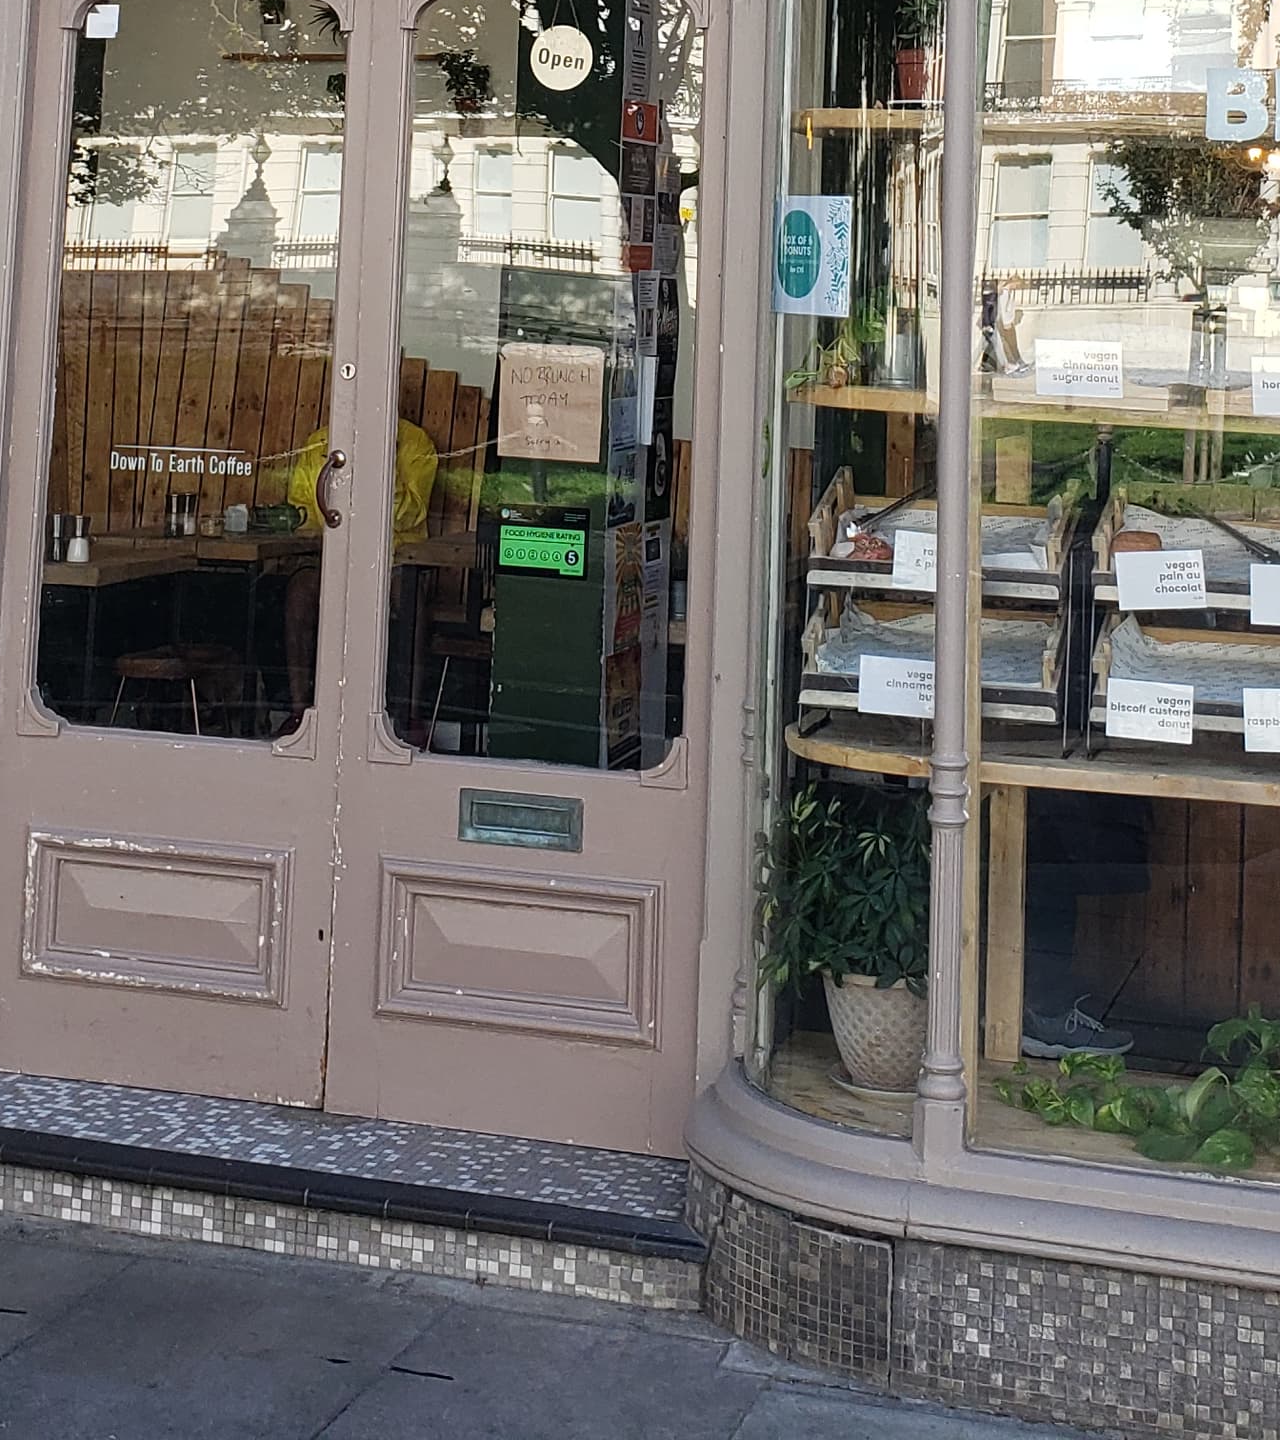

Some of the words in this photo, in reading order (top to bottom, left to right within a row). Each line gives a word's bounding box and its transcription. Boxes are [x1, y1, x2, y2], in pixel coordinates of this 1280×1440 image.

[538, 48, 585, 70] Open
[1084, 352, 1118, 362] vegan
[1063, 360, 1119, 371] cinnamon
[510, 367, 533, 385] NO
[536, 366, 591, 385] BRUNCH
[1053, 374, 1083, 384] sugar
[1086, 374, 1119, 383] donut
[520, 392, 568, 408] TODAY
[525, 436, 551, 452] Sorry
[110, 451, 146, 471] Down
[150, 453, 163, 472] To
[169, 454, 204, 473] Earth
[209, 455, 252, 476] Coffee
[505, 529, 525, 537] FOOD
[526, 530, 554, 539] HYGIENE
[556, 532, 581, 541] RATING
[568, 551, 576, 564] 5
[1165, 561, 1199, 571] vegan
[1160, 571, 1183, 583] pain
[1155, 584, 1203, 593] chocolat
[907, 671, 933, 681] vega
[886, 678, 933, 690] cinnamo
[919, 693, 933, 701] bu
[1157, 696, 1190, 707] vegan
[1111, 702, 1146, 713] biscoff
[1149, 706, 1191, 717] custard
[1158, 719, 1190, 728] donut
